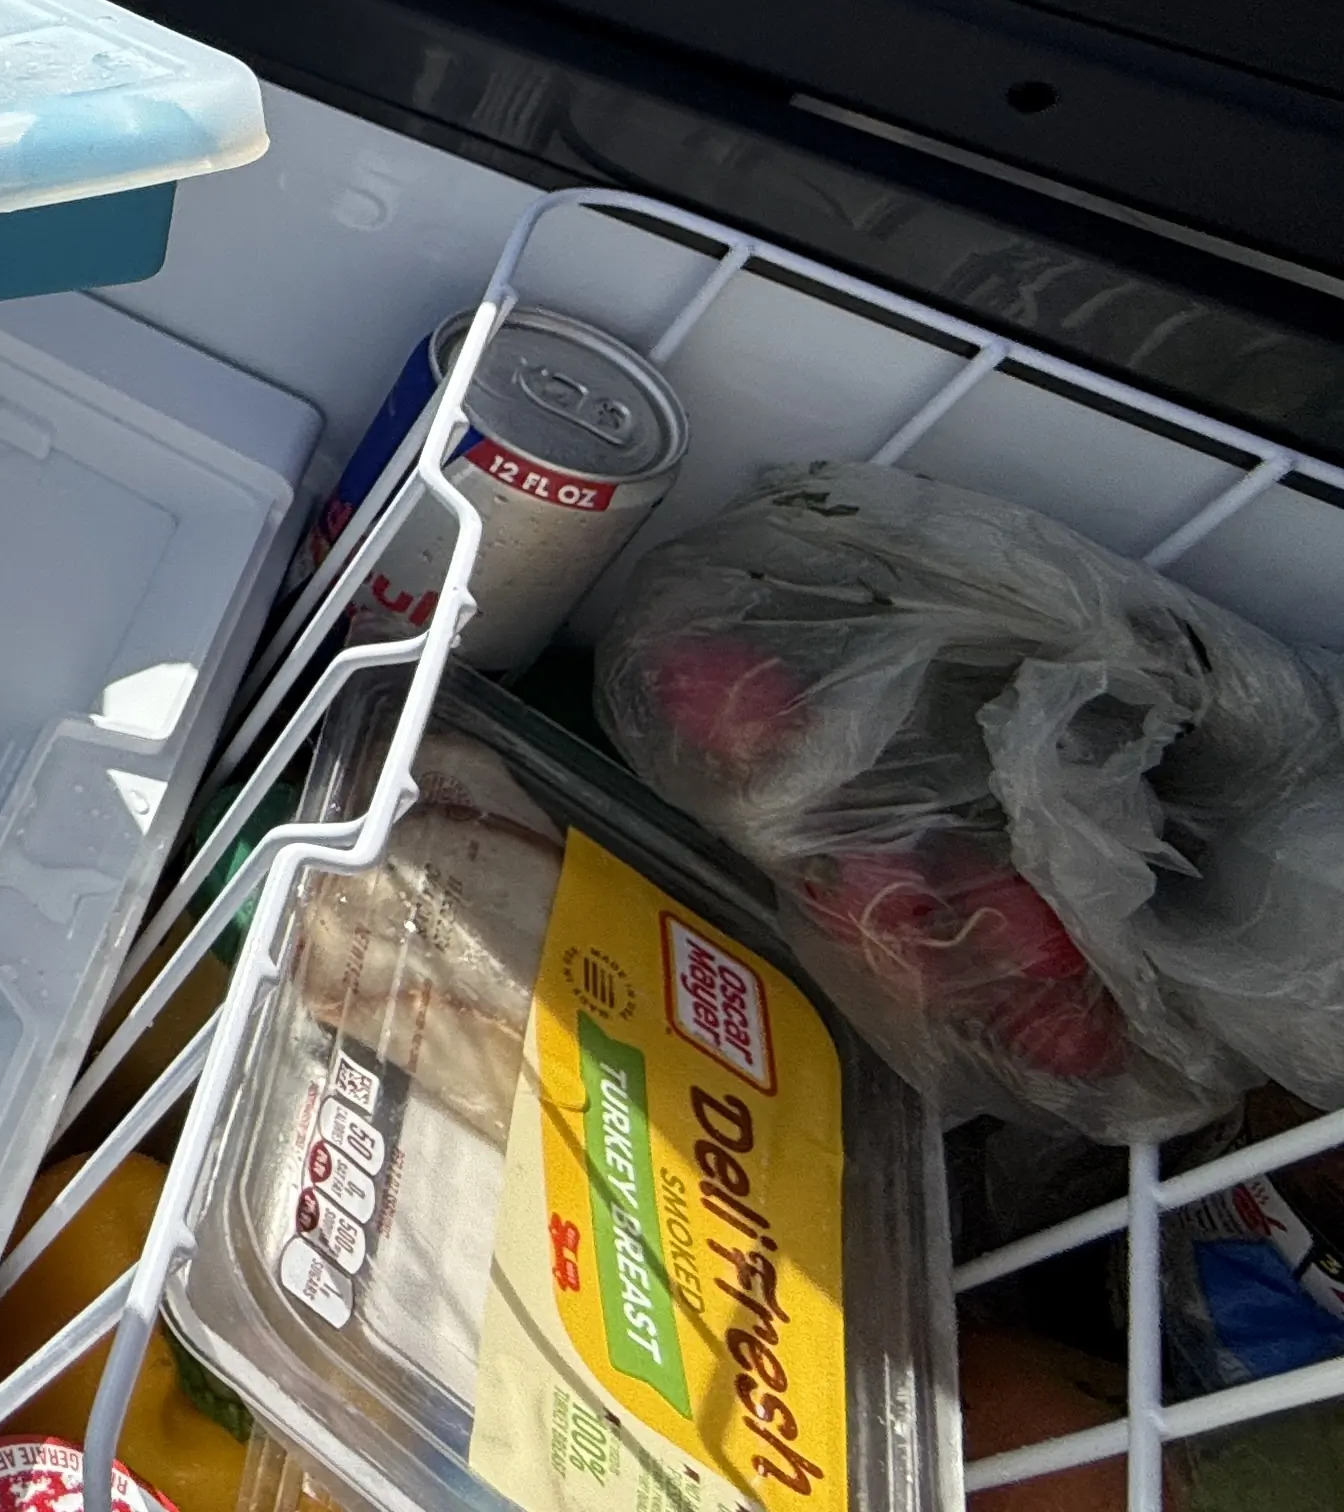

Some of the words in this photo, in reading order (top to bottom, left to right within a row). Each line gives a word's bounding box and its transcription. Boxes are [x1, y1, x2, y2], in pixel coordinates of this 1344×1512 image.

[489, 454, 519, 483] 12
[522, 472, 549, 498] FL
[557, 484, 598, 508] OZ
[680, 938, 721, 1047] Mayer
[718, 963, 753, 1067] Oscar
[347, 1122, 376, 1161] 50
[600, 1062, 638, 1209] TURKEY
[690, 1085, 778, 1252] Deli
[302, 1257, 324, 1301] SUGARS
[611, 1201, 662, 1365] BREAST
[660, 1167, 706, 1314] SMOKED
[707, 1238, 824, 1496] Fresh
[569, 1402, 607, 1487] 100%
